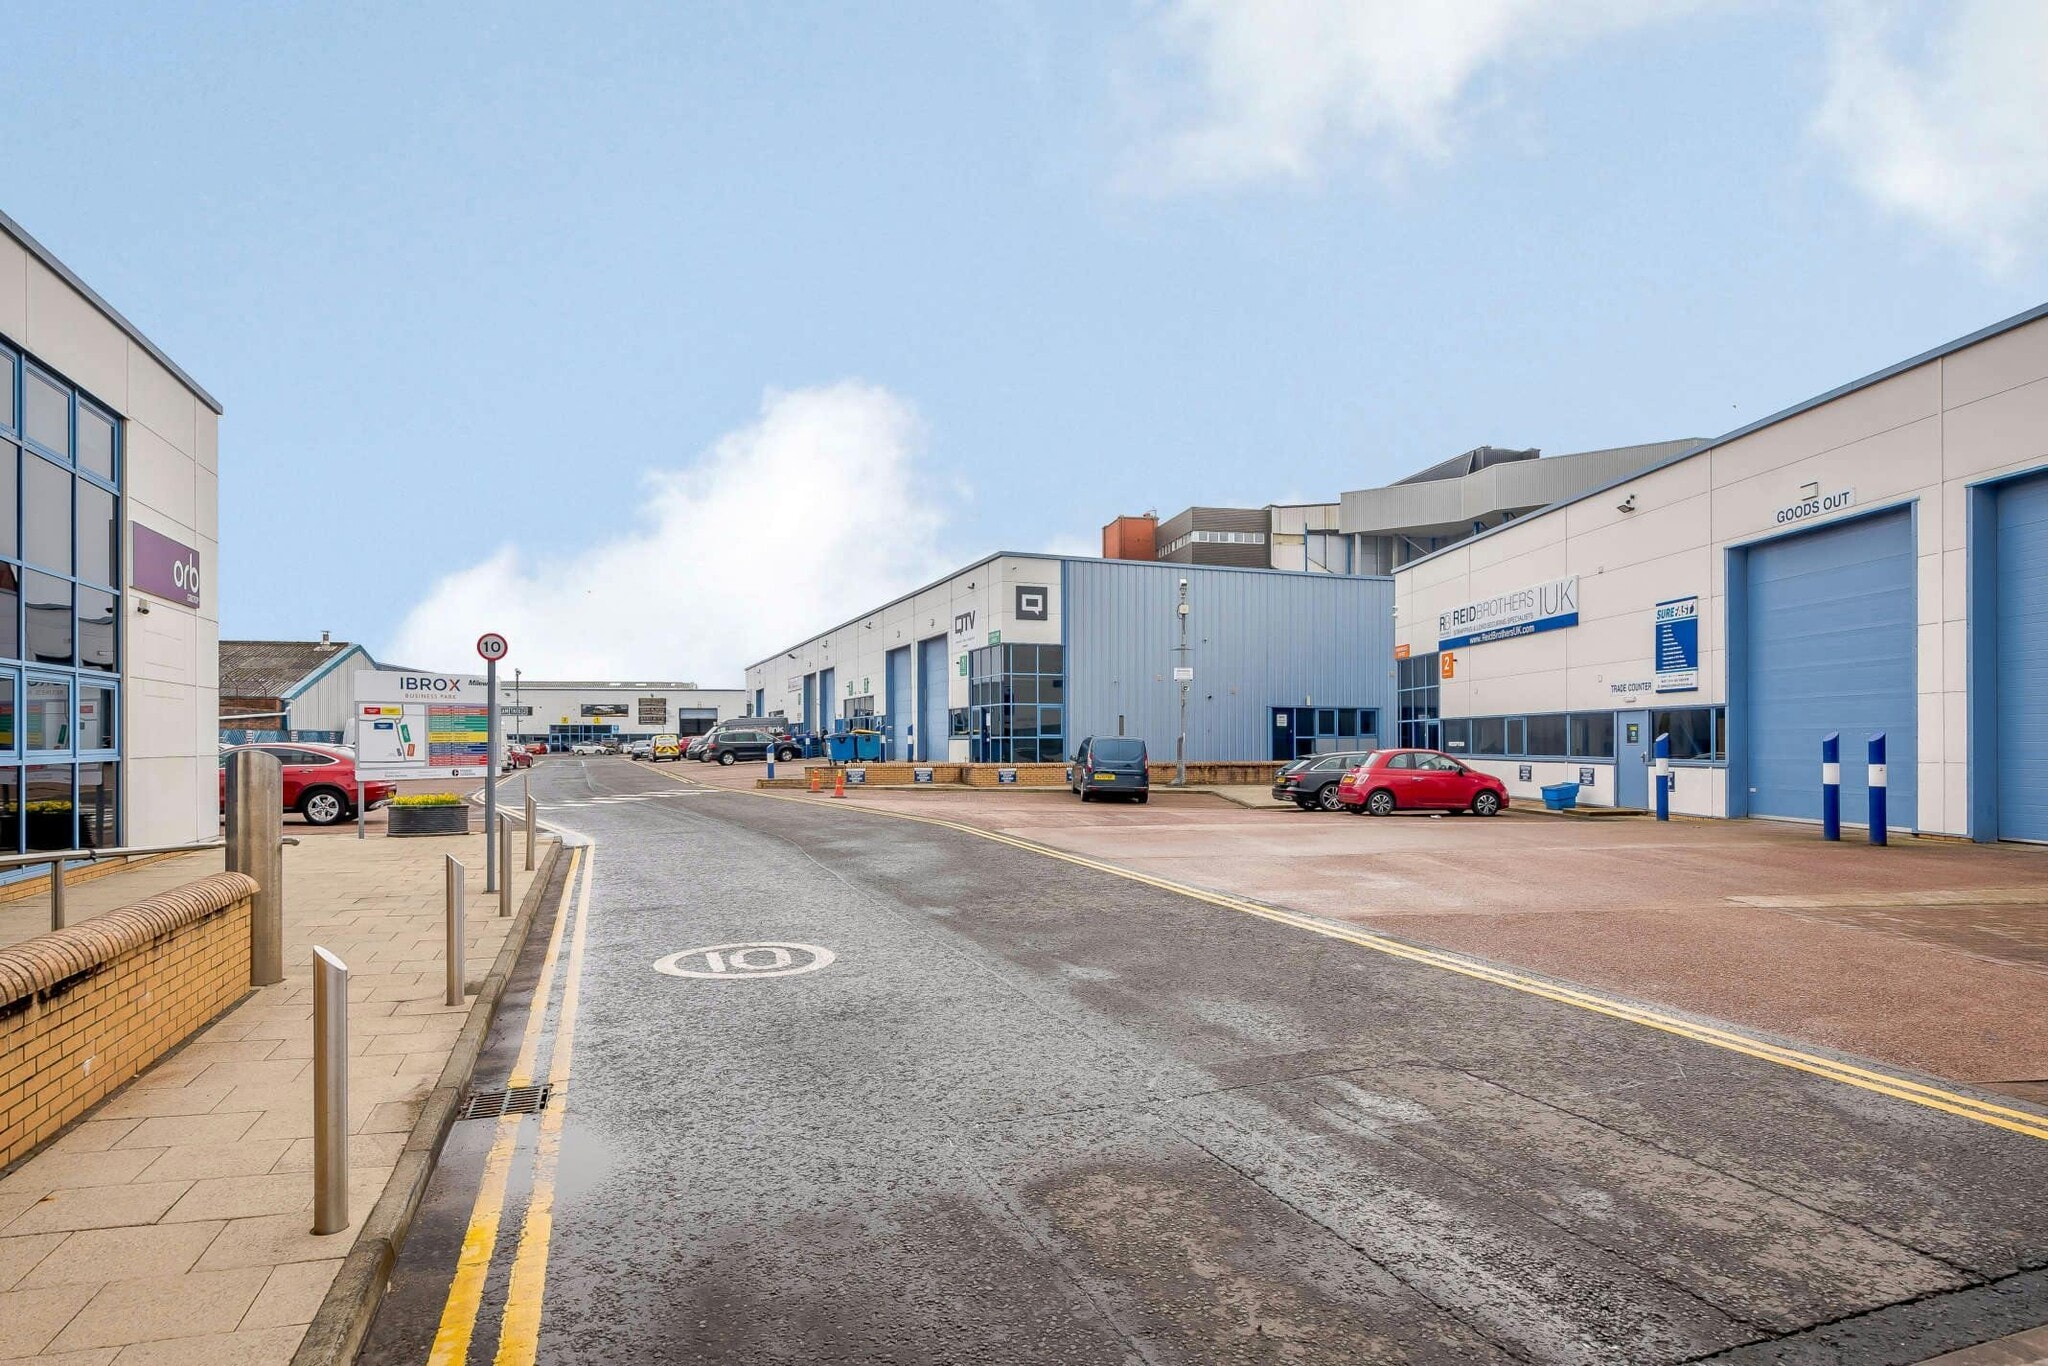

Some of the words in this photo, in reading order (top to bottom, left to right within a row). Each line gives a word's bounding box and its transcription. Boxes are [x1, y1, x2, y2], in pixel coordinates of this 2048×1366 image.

[1776, 500, 1820, 523] GOODS
[1823, 491, 1850, 510] OUT
[173, 552, 199, 593] orb
[954, 610, 976, 635] QTV
[483, 641, 501, 653] 10
[1444, 657, 1450, 671] 2
[400, 677, 461, 692] IBROX
[1611, 684, 1627, 693] TRADE
[1628, 682, 1652, 692] COUNTER
[705, 947, 792, 973] 10
